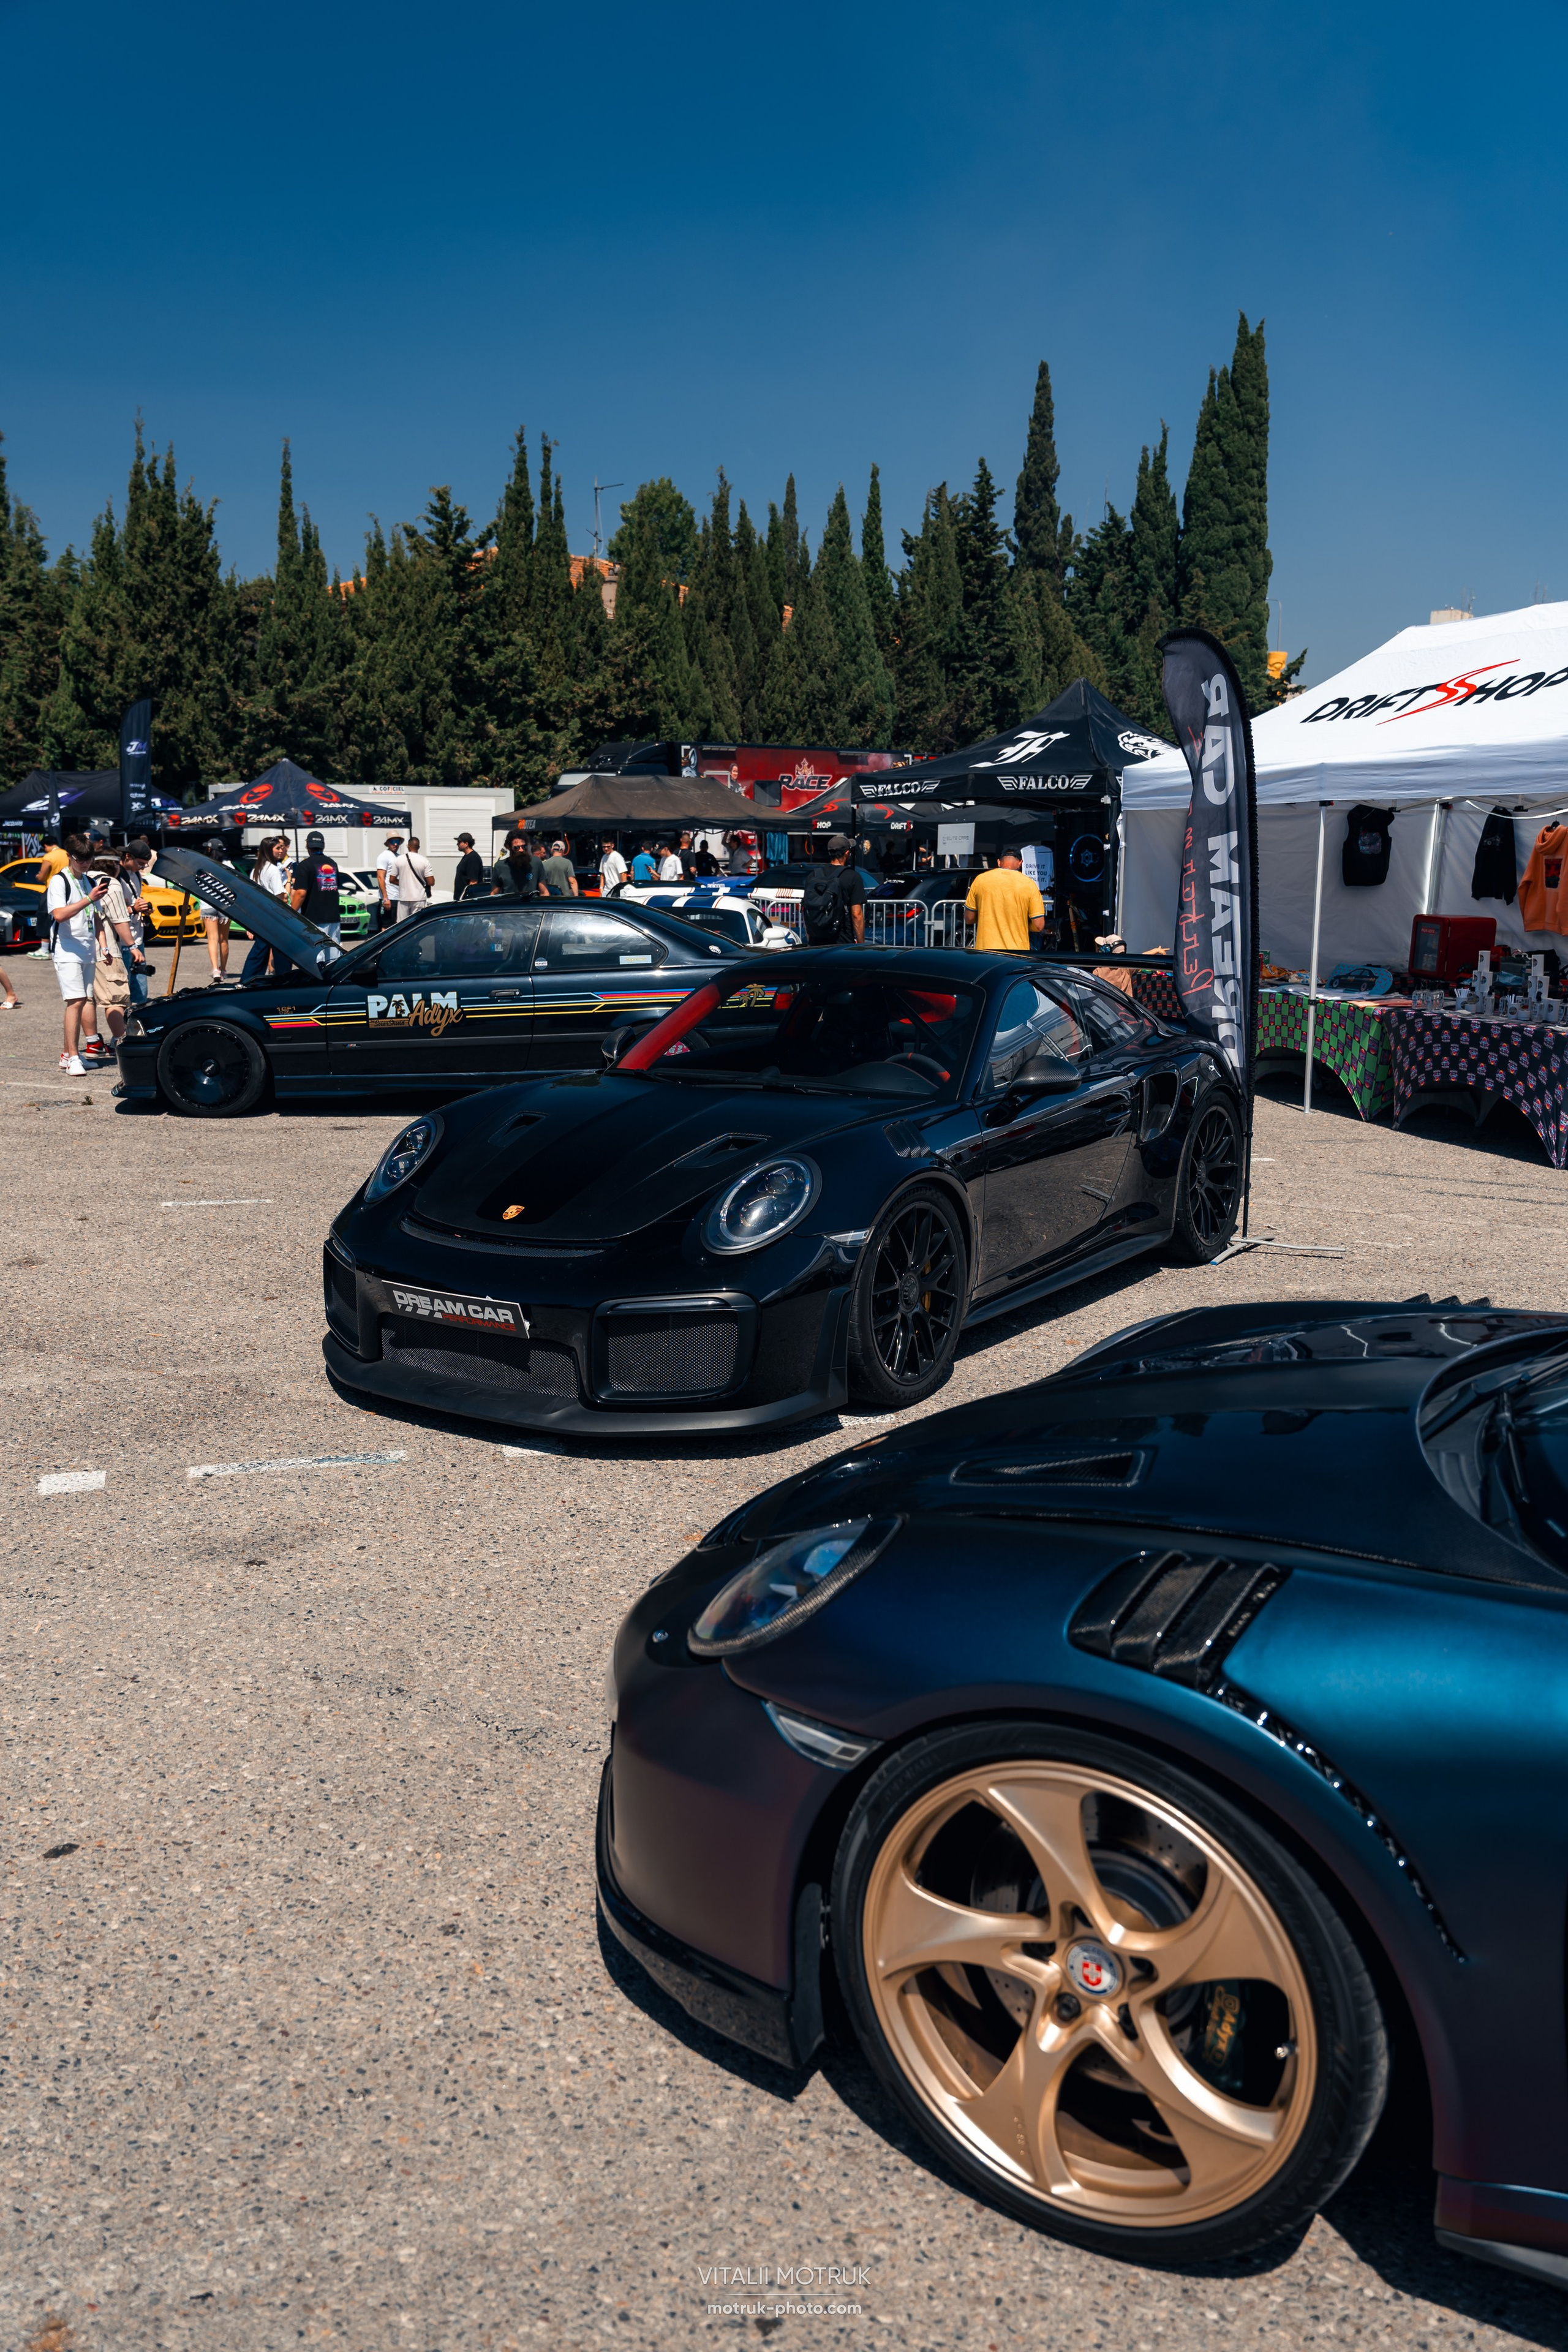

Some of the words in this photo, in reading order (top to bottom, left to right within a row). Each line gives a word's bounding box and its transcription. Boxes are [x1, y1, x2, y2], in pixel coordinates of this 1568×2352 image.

[778, 774, 832, 791] RACE
[877, 781, 922, 797] FALCO
[1017, 774, 1069, 790] FALCO
[181, 814, 219, 825] 24MX
[247, 813, 285, 823] 24MX
[315, 815, 349, 824] 24MX
[373, 816, 405, 826] 24MX
[368, 991, 458, 1019] PALM
[408, 999, 464, 1037] Adyx
[393, 1289, 467, 1316] DREAM
[467, 1304, 514, 1324] CAR
[442, 1313, 517, 1332] PERFORMANCE
